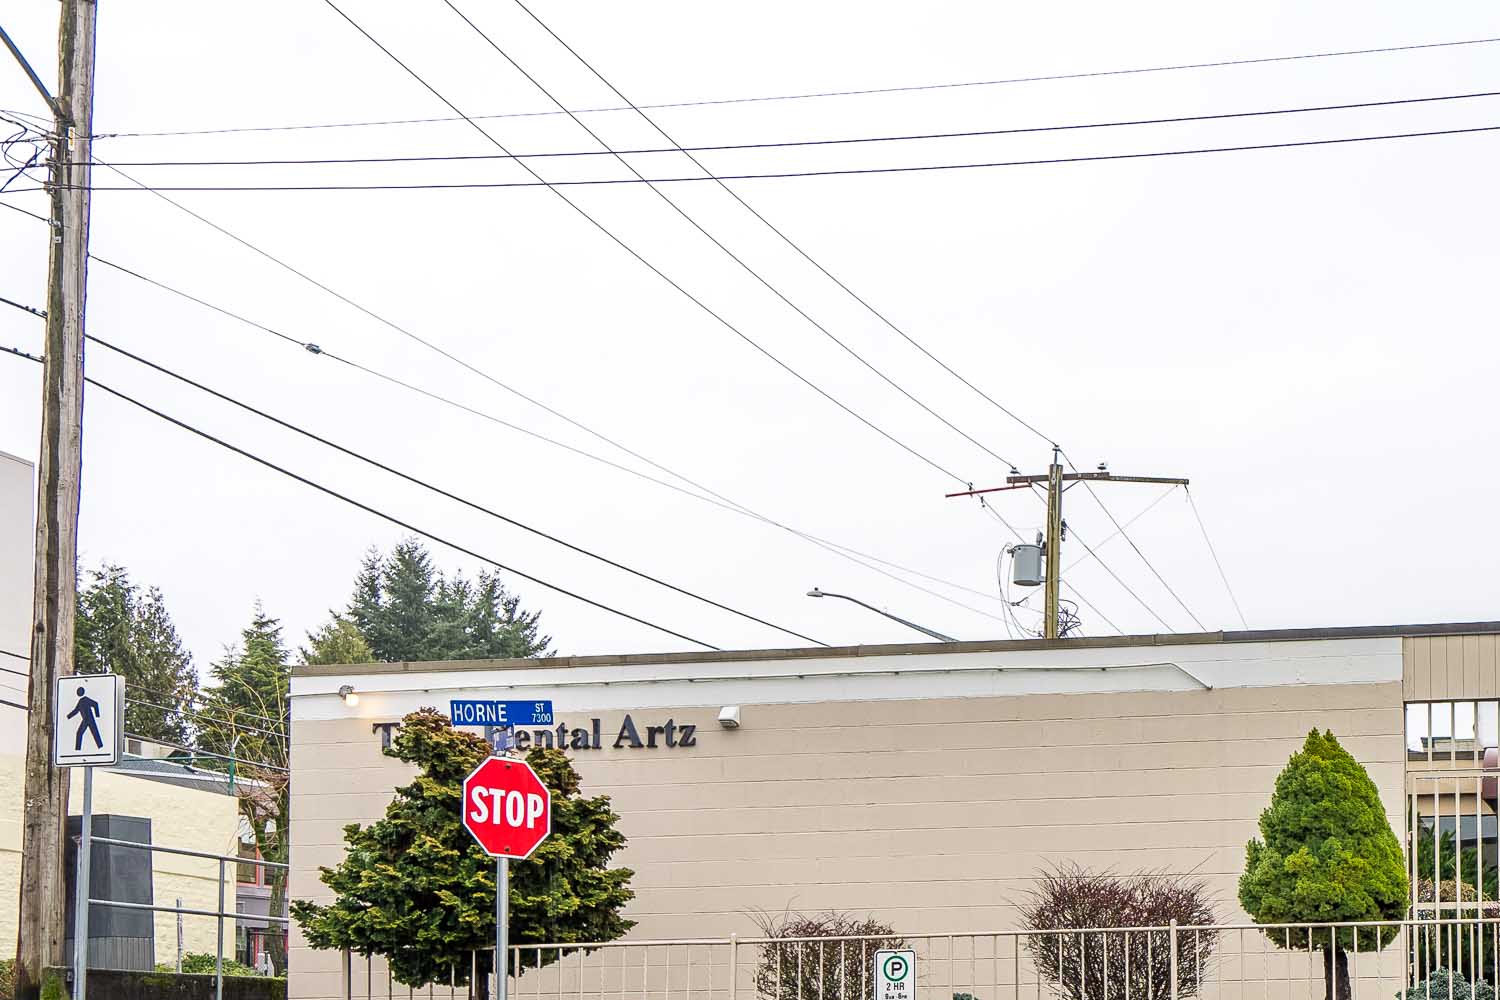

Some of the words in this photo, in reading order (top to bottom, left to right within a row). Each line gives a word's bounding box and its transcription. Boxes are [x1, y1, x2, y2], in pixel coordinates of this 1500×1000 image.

[453, 703, 508, 722] HORNE
[535, 702, 545, 713] ST
[531, 713, 552, 723] 7300
[612, 714, 697, 749] Artz
[470, 785, 545, 829] STOP
[891, 961, 902, 976] P
[886, 982, 891, 991] 2
[893, 982, 904, 990] HR
